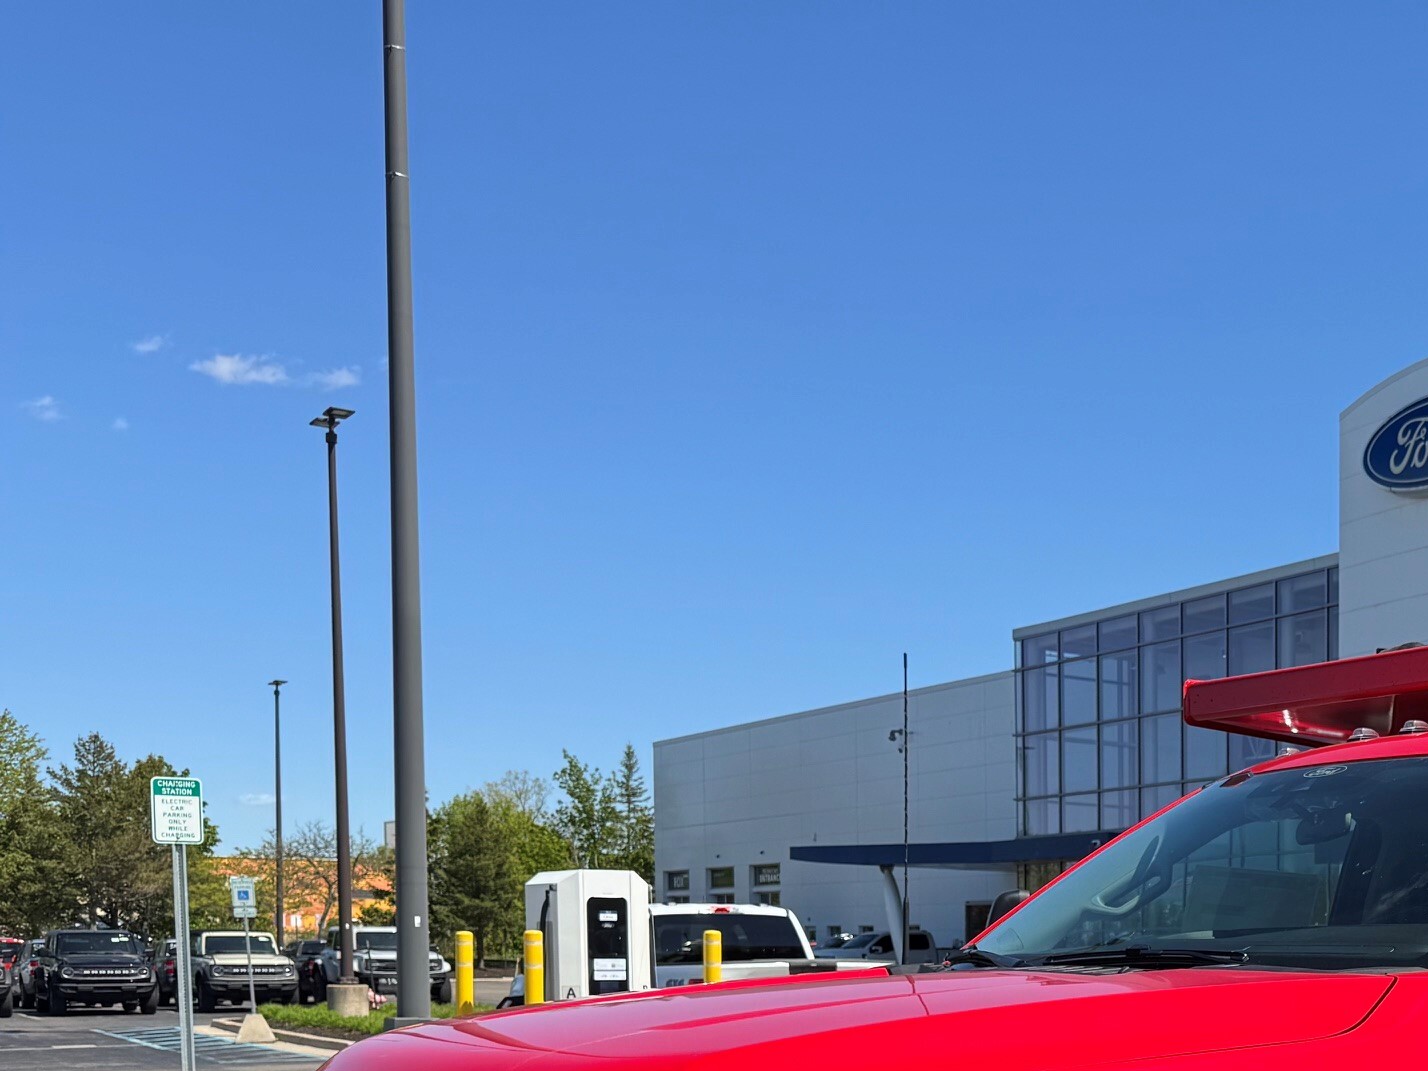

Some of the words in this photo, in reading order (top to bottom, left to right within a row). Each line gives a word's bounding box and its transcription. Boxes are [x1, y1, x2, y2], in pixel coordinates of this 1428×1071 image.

[157, 780, 196, 788] CHARGING
[161, 787, 192, 795] STATION
[566, 987, 576, 999] A
